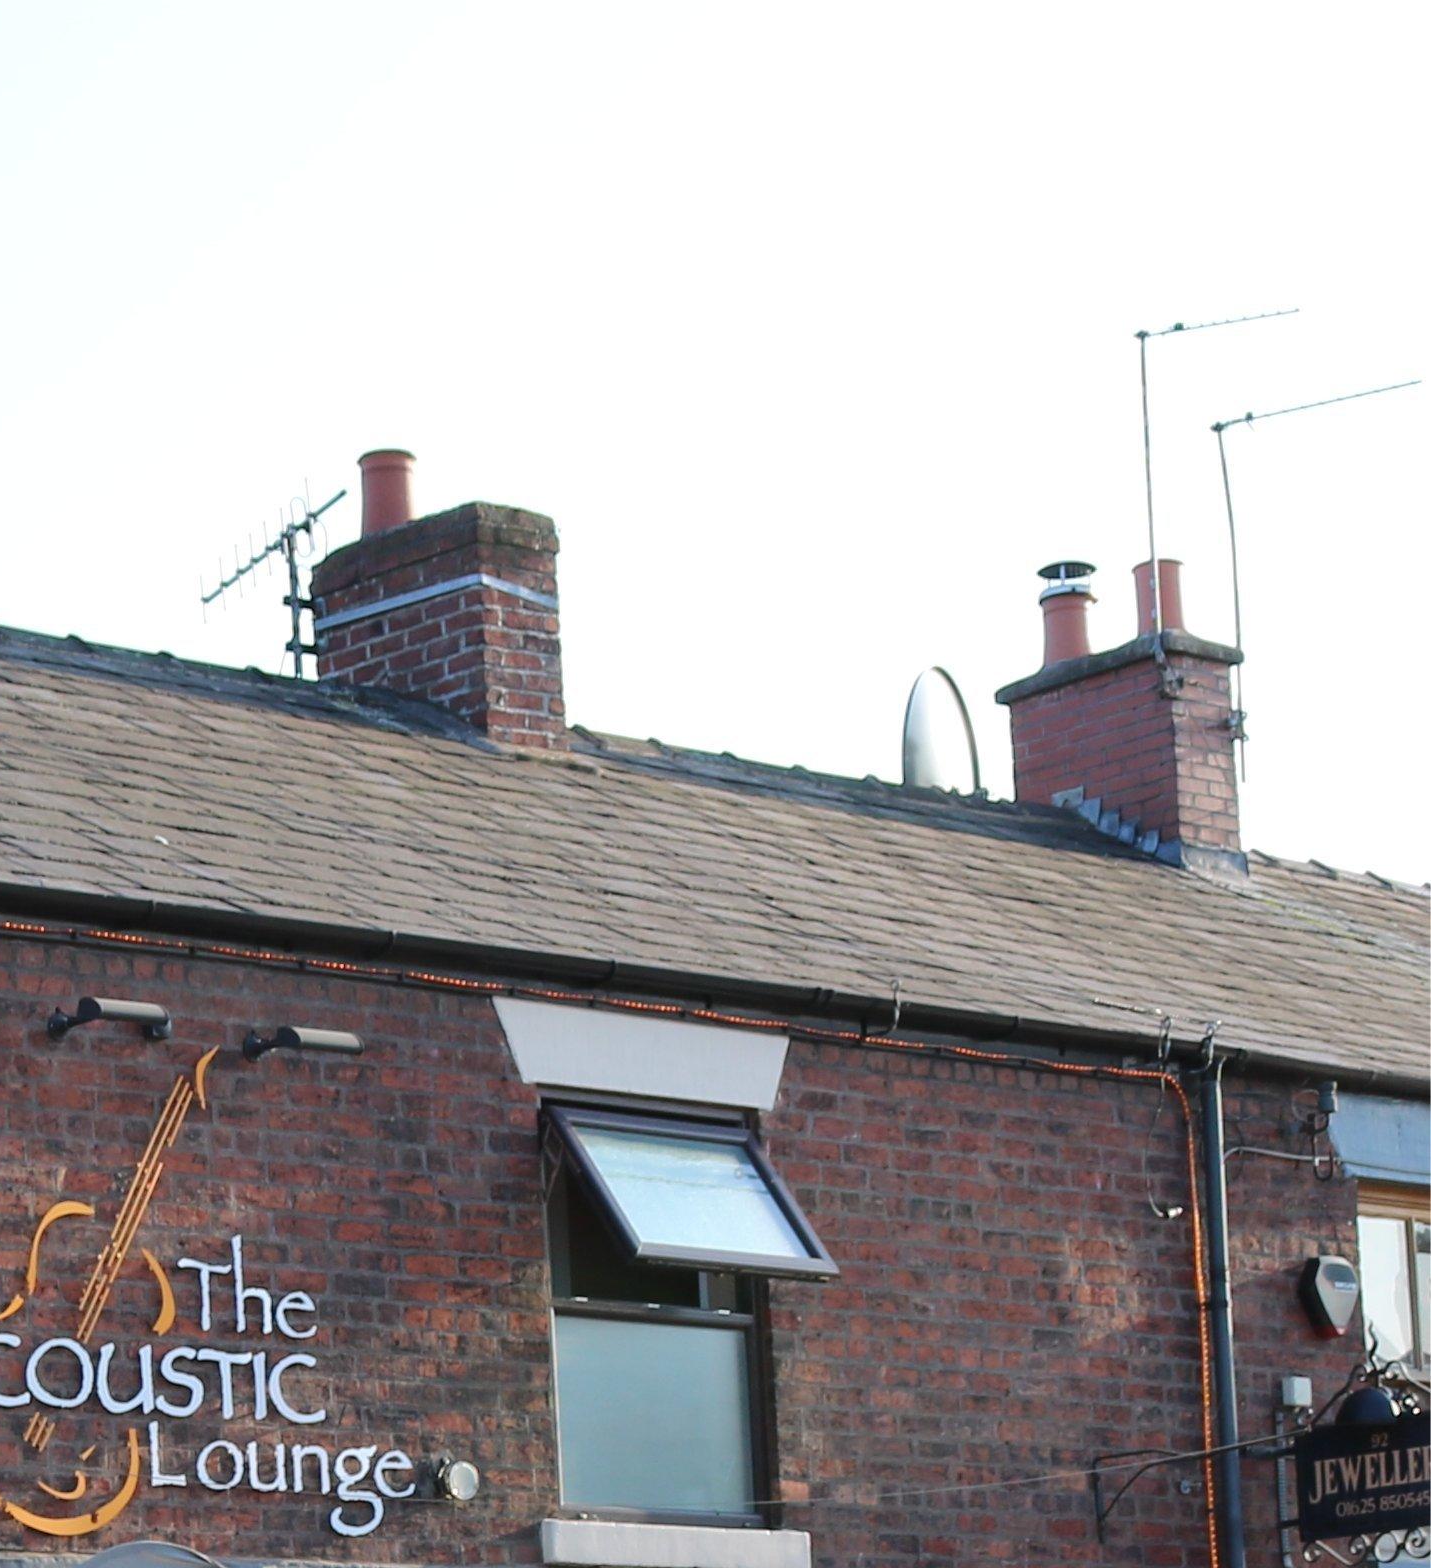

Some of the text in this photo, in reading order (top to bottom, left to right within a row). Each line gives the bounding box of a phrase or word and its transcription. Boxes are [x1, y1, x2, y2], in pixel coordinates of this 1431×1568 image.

[177, 1235, 318, 1338] The
[149, 1420, 416, 1538] Lounge
[1371, 1432, 1388, 1447] 92
